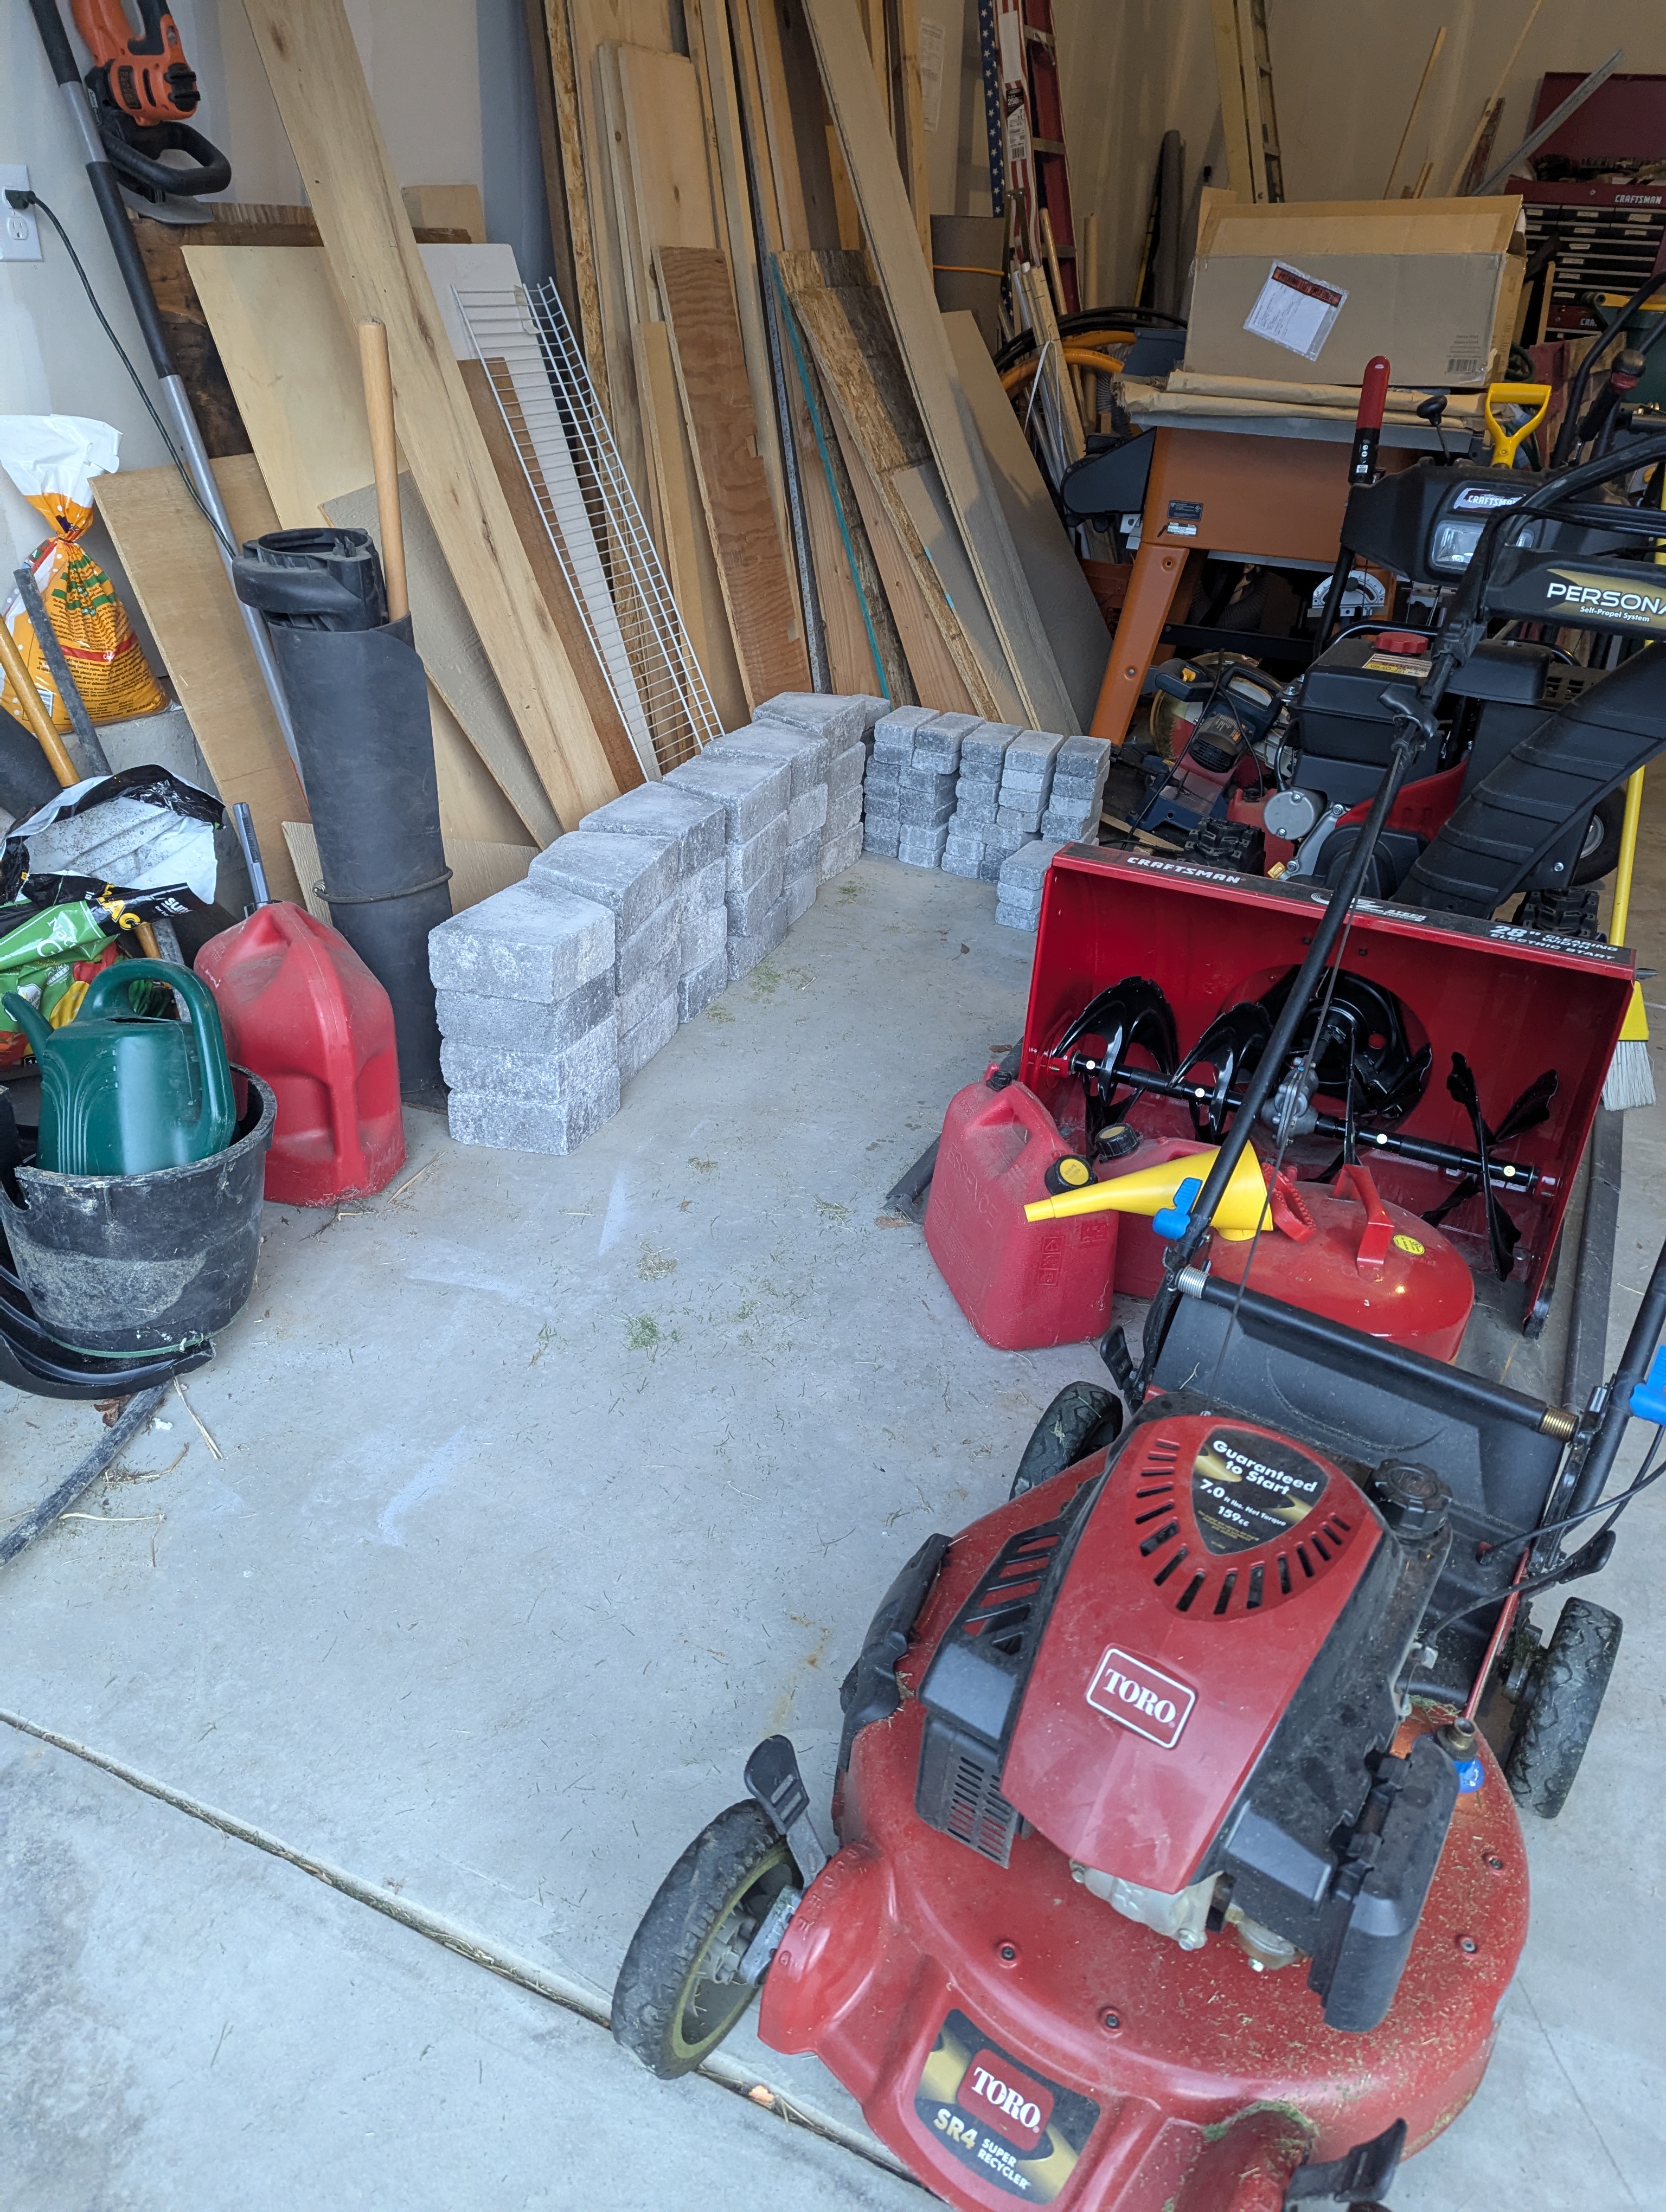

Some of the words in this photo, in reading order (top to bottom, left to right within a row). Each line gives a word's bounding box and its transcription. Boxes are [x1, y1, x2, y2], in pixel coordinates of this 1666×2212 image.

[1614, 195, 1662, 204] CRAFTSMAN
[1468, 495, 1516, 507] CRAFTSMA
[1580, 606, 1622, 618] Self-Propel
[1623, 612, 1650, 622] System
[1126, 857, 1241, 884] CRAFTSMAN
[1490, 925, 1541, 938] 28"
[1545, 934, 1618, 952] CLEARING
[1490, 934, 1561, 950] ELECTRIC
[1565, 948, 1615, 960] START
[1542, 937, 1590, 950] WIDTH
[1213, 1440, 1318, 1493] Guaranteed
[1225, 1461, 1243, 1475] to
[1246, 1470, 1290, 1495] Start
[1199, 1478, 1226, 1499] 7.0
[1231, 1499, 1244, 1510] lbs.
[1245, 1506, 1260, 1516] Net
[1260, 1512, 1287, 1527] Torque
[1218, 1505, 1250, 1527] 159cc
[1103, 1668, 1176, 1724] TORO
[971, 2066, 1041, 2128] TORO
[933, 2108, 978, 2150] SR4
[981, 2138, 1017, 2168] SUPER
[977, 2148, 1028, 2190] RECYCLER
